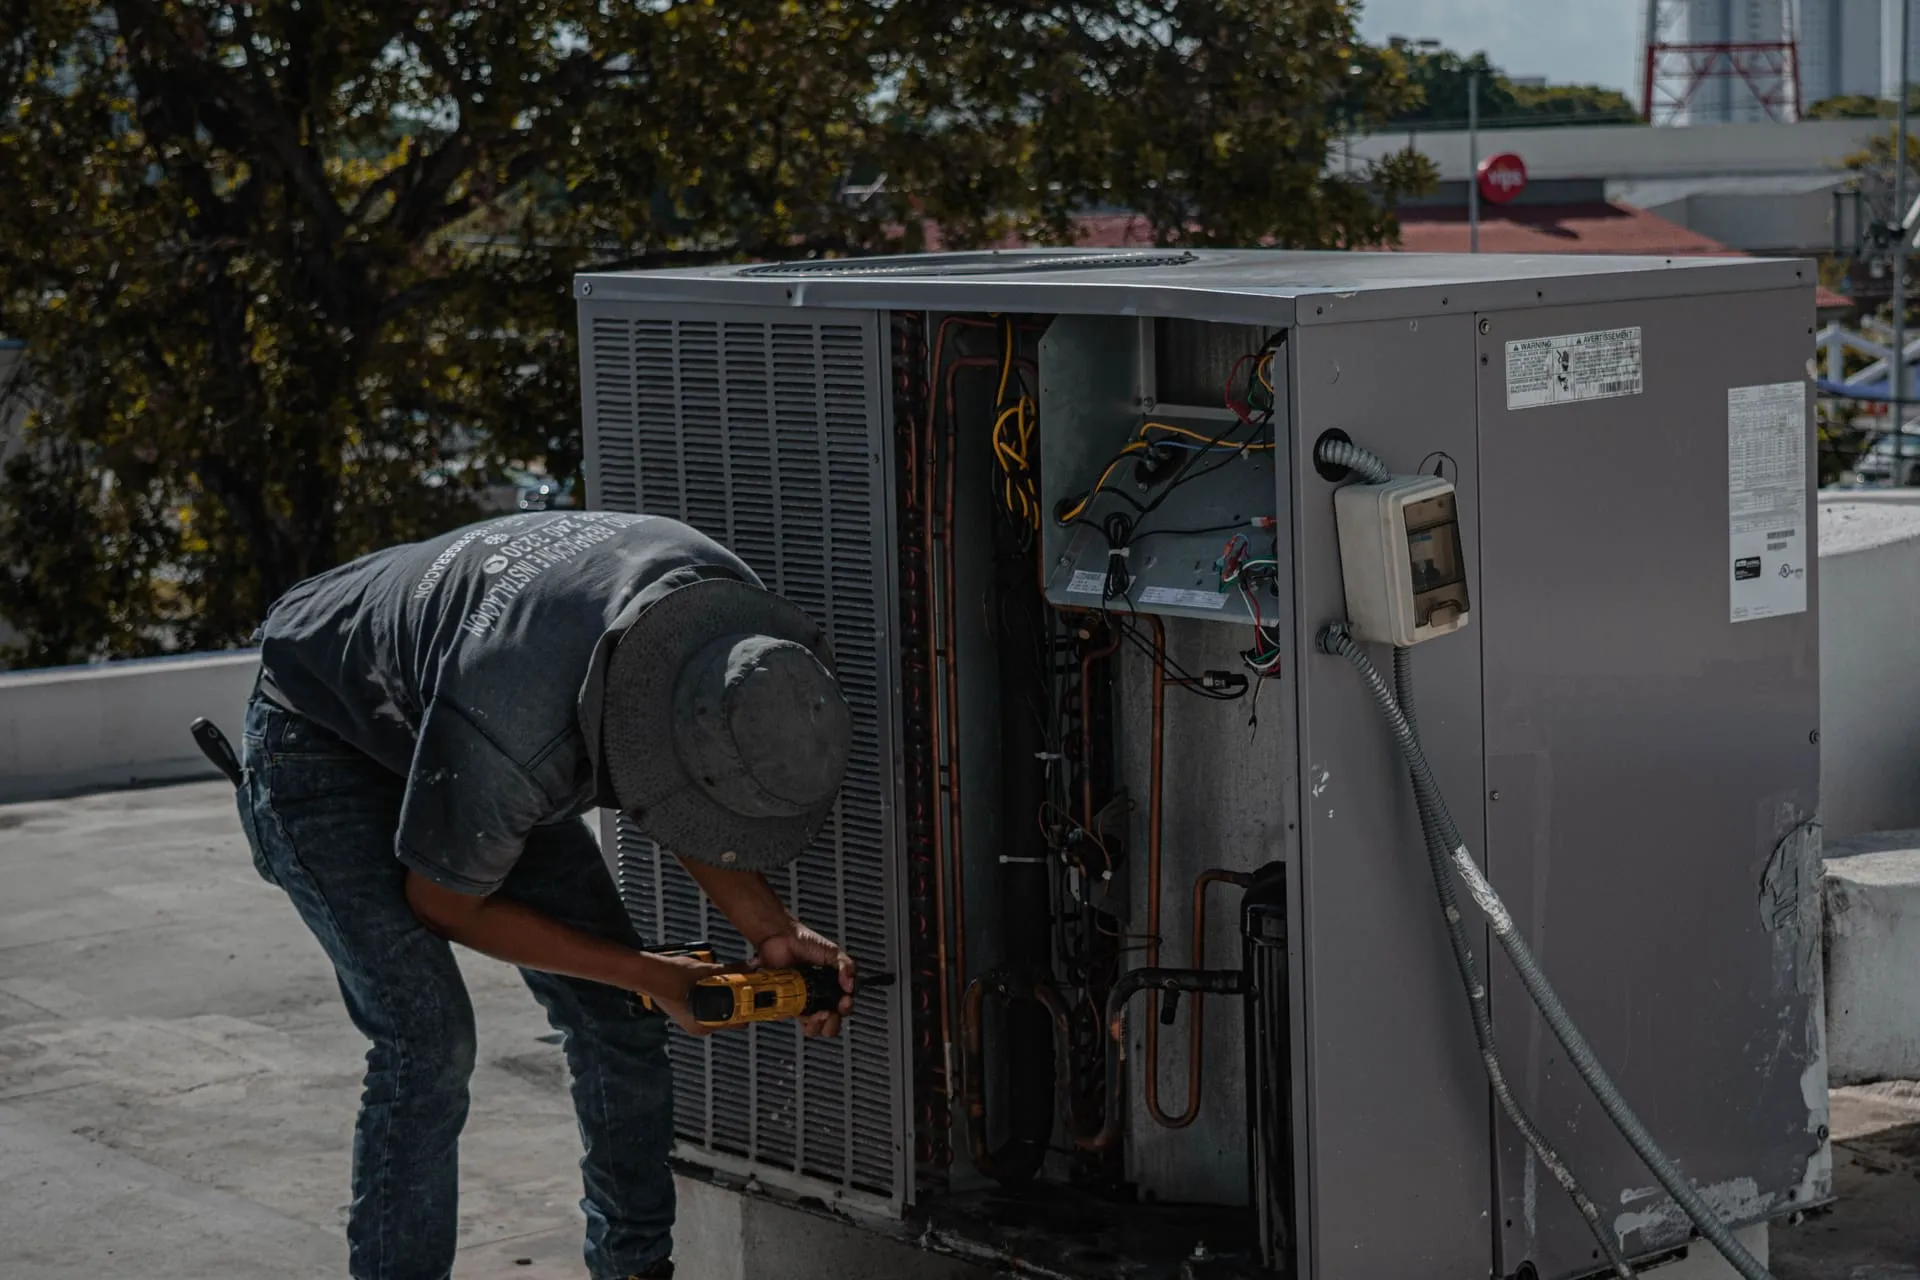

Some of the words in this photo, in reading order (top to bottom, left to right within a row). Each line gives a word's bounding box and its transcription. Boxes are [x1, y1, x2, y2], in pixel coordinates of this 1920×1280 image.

[1521, 340, 1552, 350] WARNING
[1583, 331, 1633, 343] AVERTISSEMENT
[541, 519, 582, 537] 240
[500, 533, 551, 557] 3230
[463, 560, 542, 637] INSTALACIÓN
